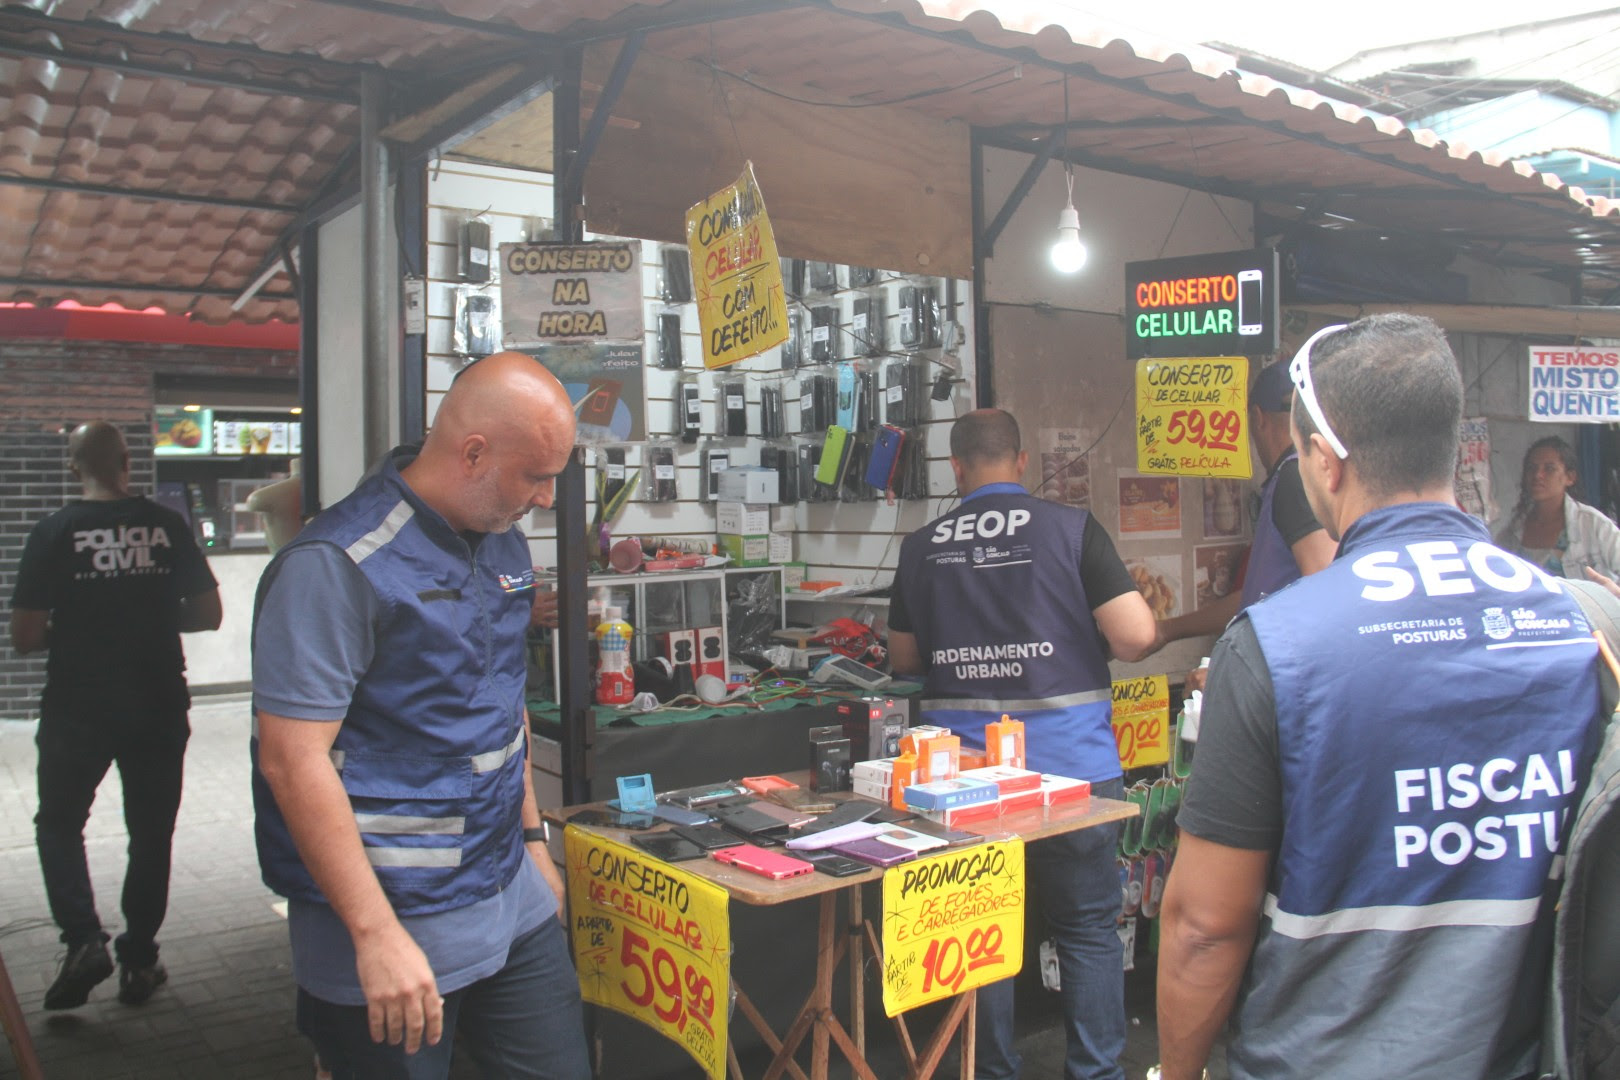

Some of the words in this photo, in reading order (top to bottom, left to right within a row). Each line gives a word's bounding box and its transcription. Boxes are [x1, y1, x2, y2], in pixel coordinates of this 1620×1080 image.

[508, 249, 633, 275] CONSERTO
[705, 225, 762, 280] CELULAR
[552, 279, 590, 305] NA
[723, 281, 756, 319] COM
[1136, 275, 1237, 308] CONSERTO
[538, 311, 607, 337] HORA
[1136, 309, 1234, 338] CELULAR
[1533, 352, 1619, 367] TEMOS
[1148, 363, 1233, 387] CONSERTO
[1532, 367, 1619, 389] MISTO
[1156, 389, 1168, 401] DE
[1170, 389, 1221, 403] CELULAR
[1533, 390, 1619, 416] QUENTE
[1145, 432, 1155, 446] DE
[1166, 409, 1241, 449] 59,99
[1147, 453, 1177, 469] GRÁTIS
[1180, 453, 1232, 469] PELÍCULA
[931, 509, 1031, 544] SEOP
[93, 546, 156, 572] CIVIL
[1358, 618, 1447, 635] SUBSECRETARIA
[1450, 616, 1463, 626] DE
[1511, 607, 1536, 620] SÃO
[1393, 628, 1467, 645] POSTURAS
[956, 662, 1023, 680] URBANO
[1112, 677, 1156, 702] OMOÇÃO
[1394, 806, 1569, 868] POSTU
[587, 847, 689, 914] CONSERTO
[901, 845, 1005, 900] PROMOÇÃO
[920, 895, 941, 919] DE
[945, 882, 994, 911] FONES
[589, 880, 606, 904] DE
[610, 888, 703, 950] CELULAR
[897, 924, 910, 942] E
[913, 890, 1022, 936] CARREGADORES
[591, 932, 605, 946] DE
[887, 954, 896, 971] A
[887, 951, 916, 985] PARTIR
[922, 923, 1003, 994] 10,00
[620, 925, 715, 1034] 59,99
[895, 973, 909, 992] DE
